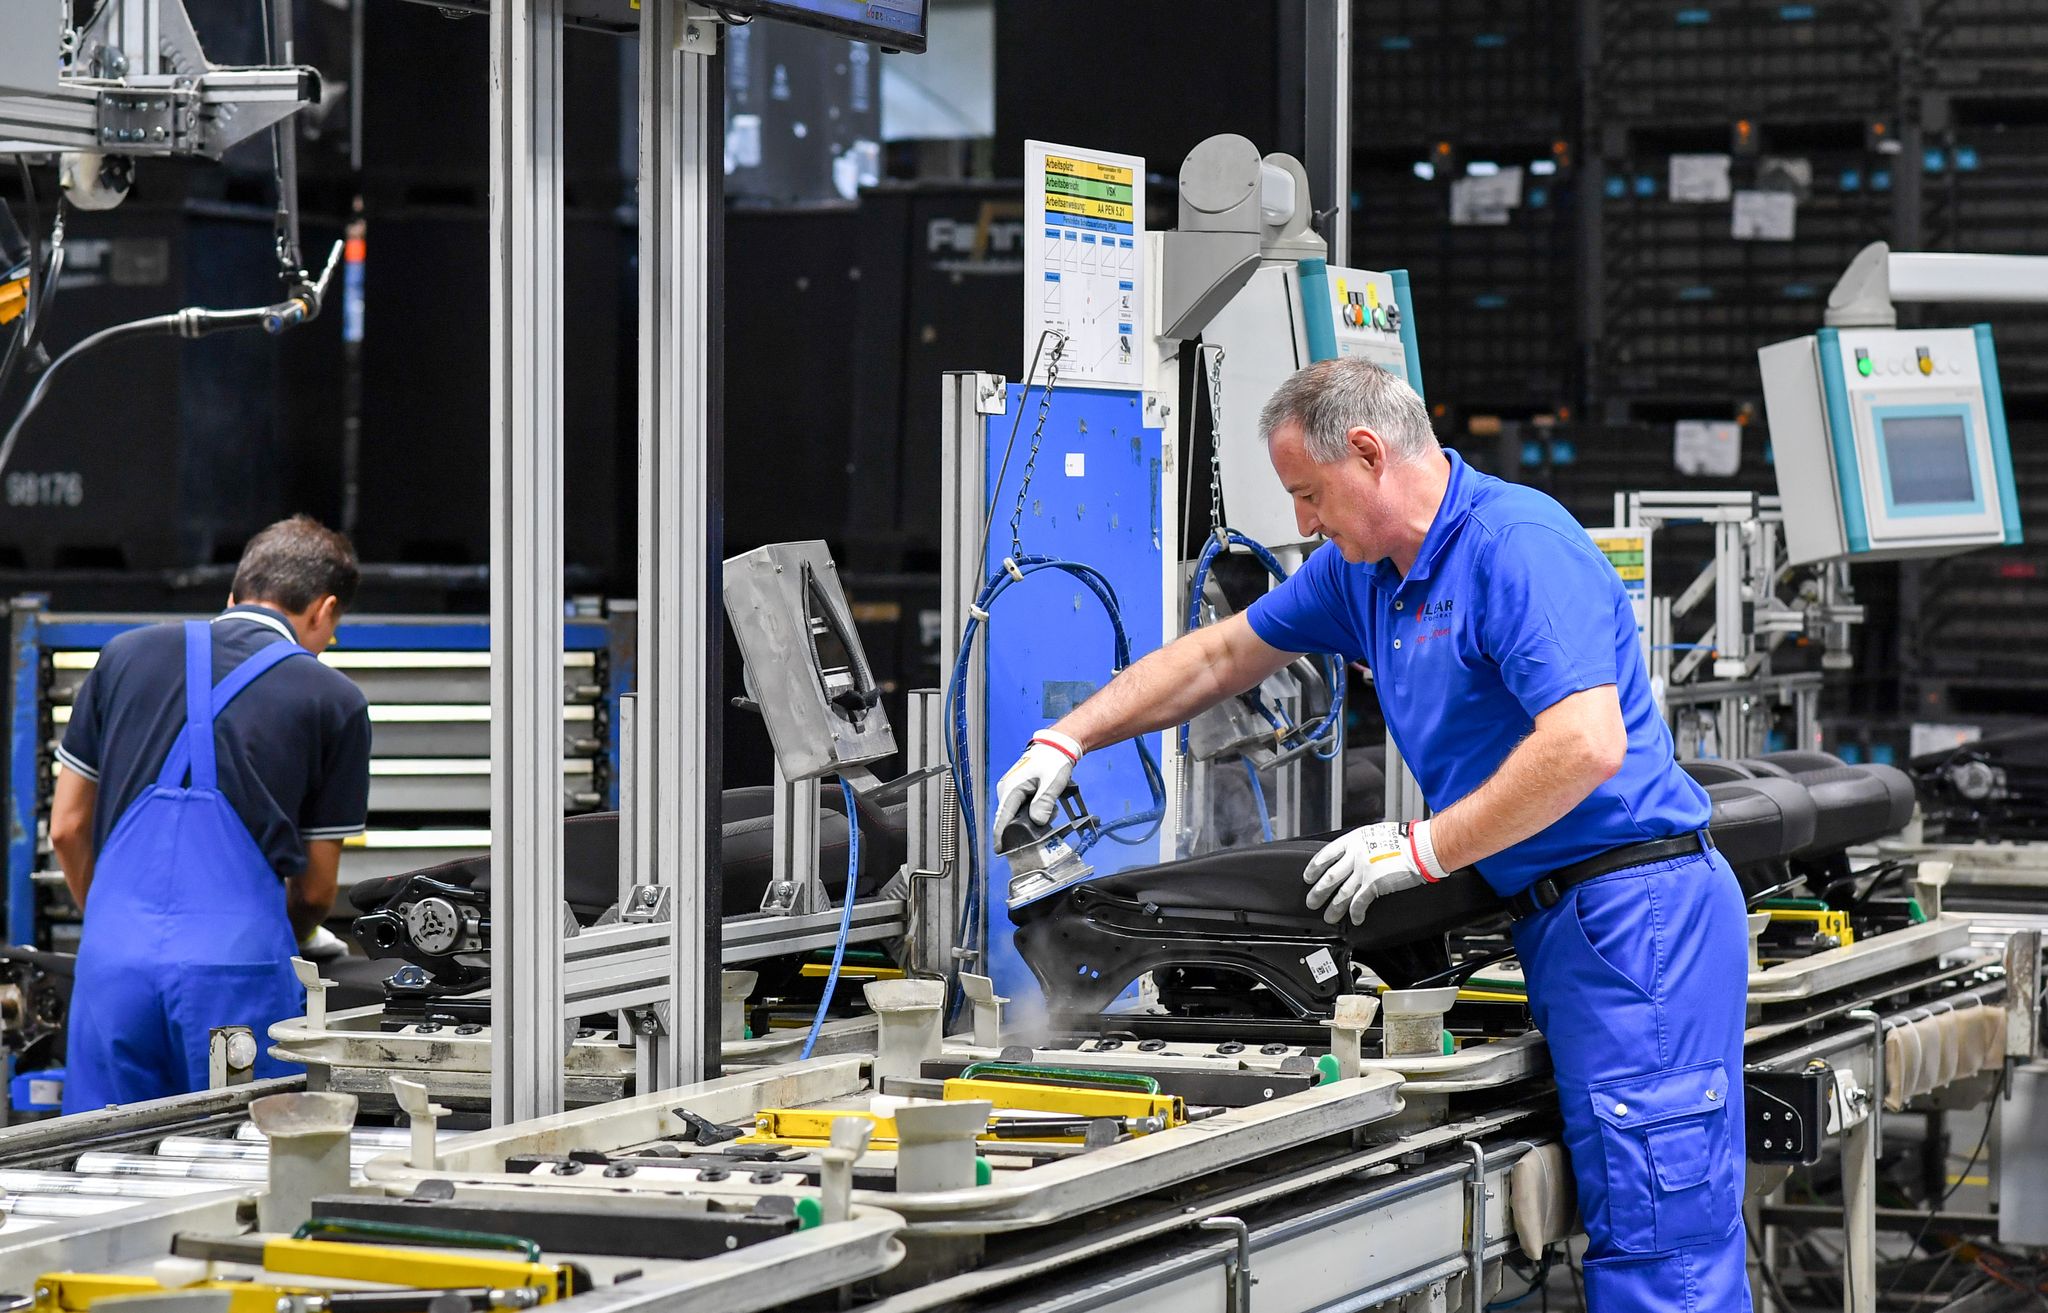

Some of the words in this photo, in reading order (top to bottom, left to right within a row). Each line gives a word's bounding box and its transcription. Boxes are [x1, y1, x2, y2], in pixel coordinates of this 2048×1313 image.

[1106, 186, 1116, 197] VSK
[1098, 204, 1104, 214] AA
[1105, 205, 1115, 215] PEN
[1116, 206, 1125, 216] 5.21
[1425, 600, 1453, 615] LAR
